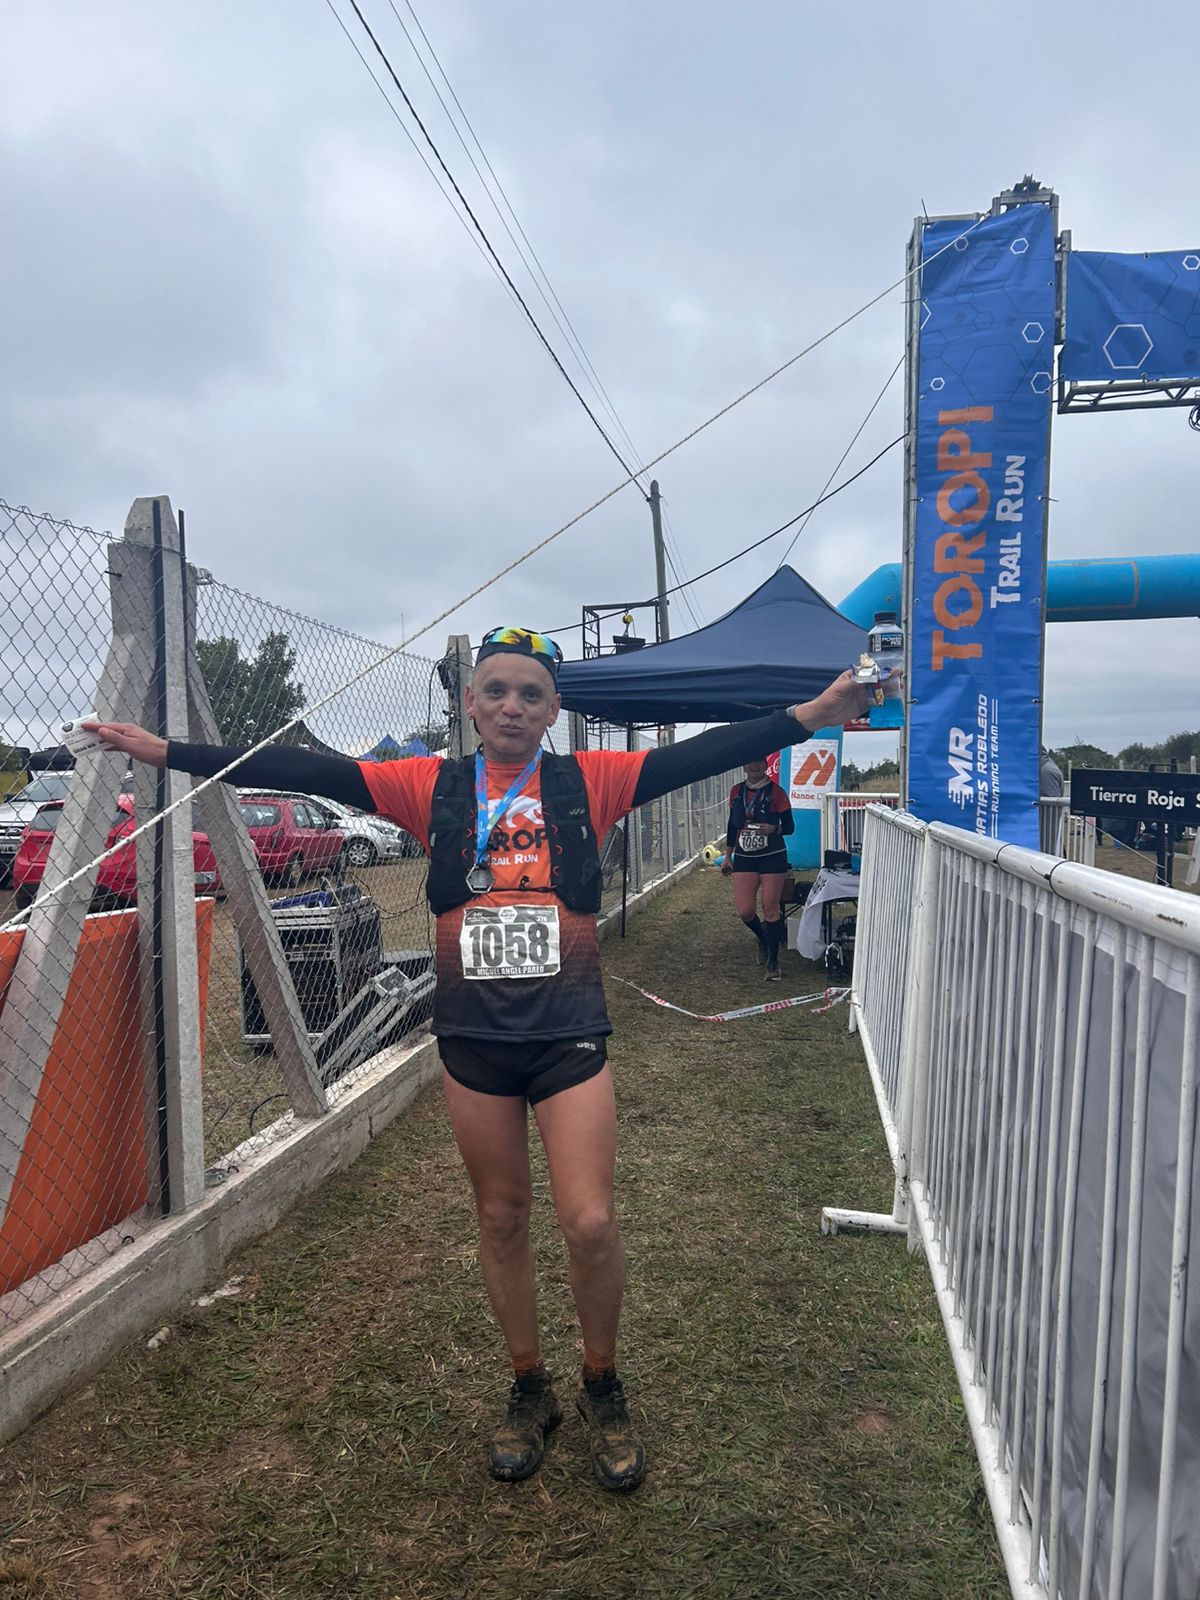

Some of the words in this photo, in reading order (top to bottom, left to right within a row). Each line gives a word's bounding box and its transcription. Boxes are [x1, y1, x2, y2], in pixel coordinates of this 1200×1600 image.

[996, 455, 1026, 521] RUN
[932, 405, 993, 670] TOROPI
[990, 532, 1021, 608] TRAIL
[977, 694, 988, 774] ROBLEDO
[948, 726, 974, 801] MR
[991, 763, 1000, 812] RUNNING
[1090, 786, 1137, 804] Tierra
[1147, 789, 1185, 810] Roja
[487, 855, 511, 866] RAIL
[514, 854, 539, 864] RUN
[469, 923, 549, 967] 1058
[501, 966, 521, 975] ANGEL
